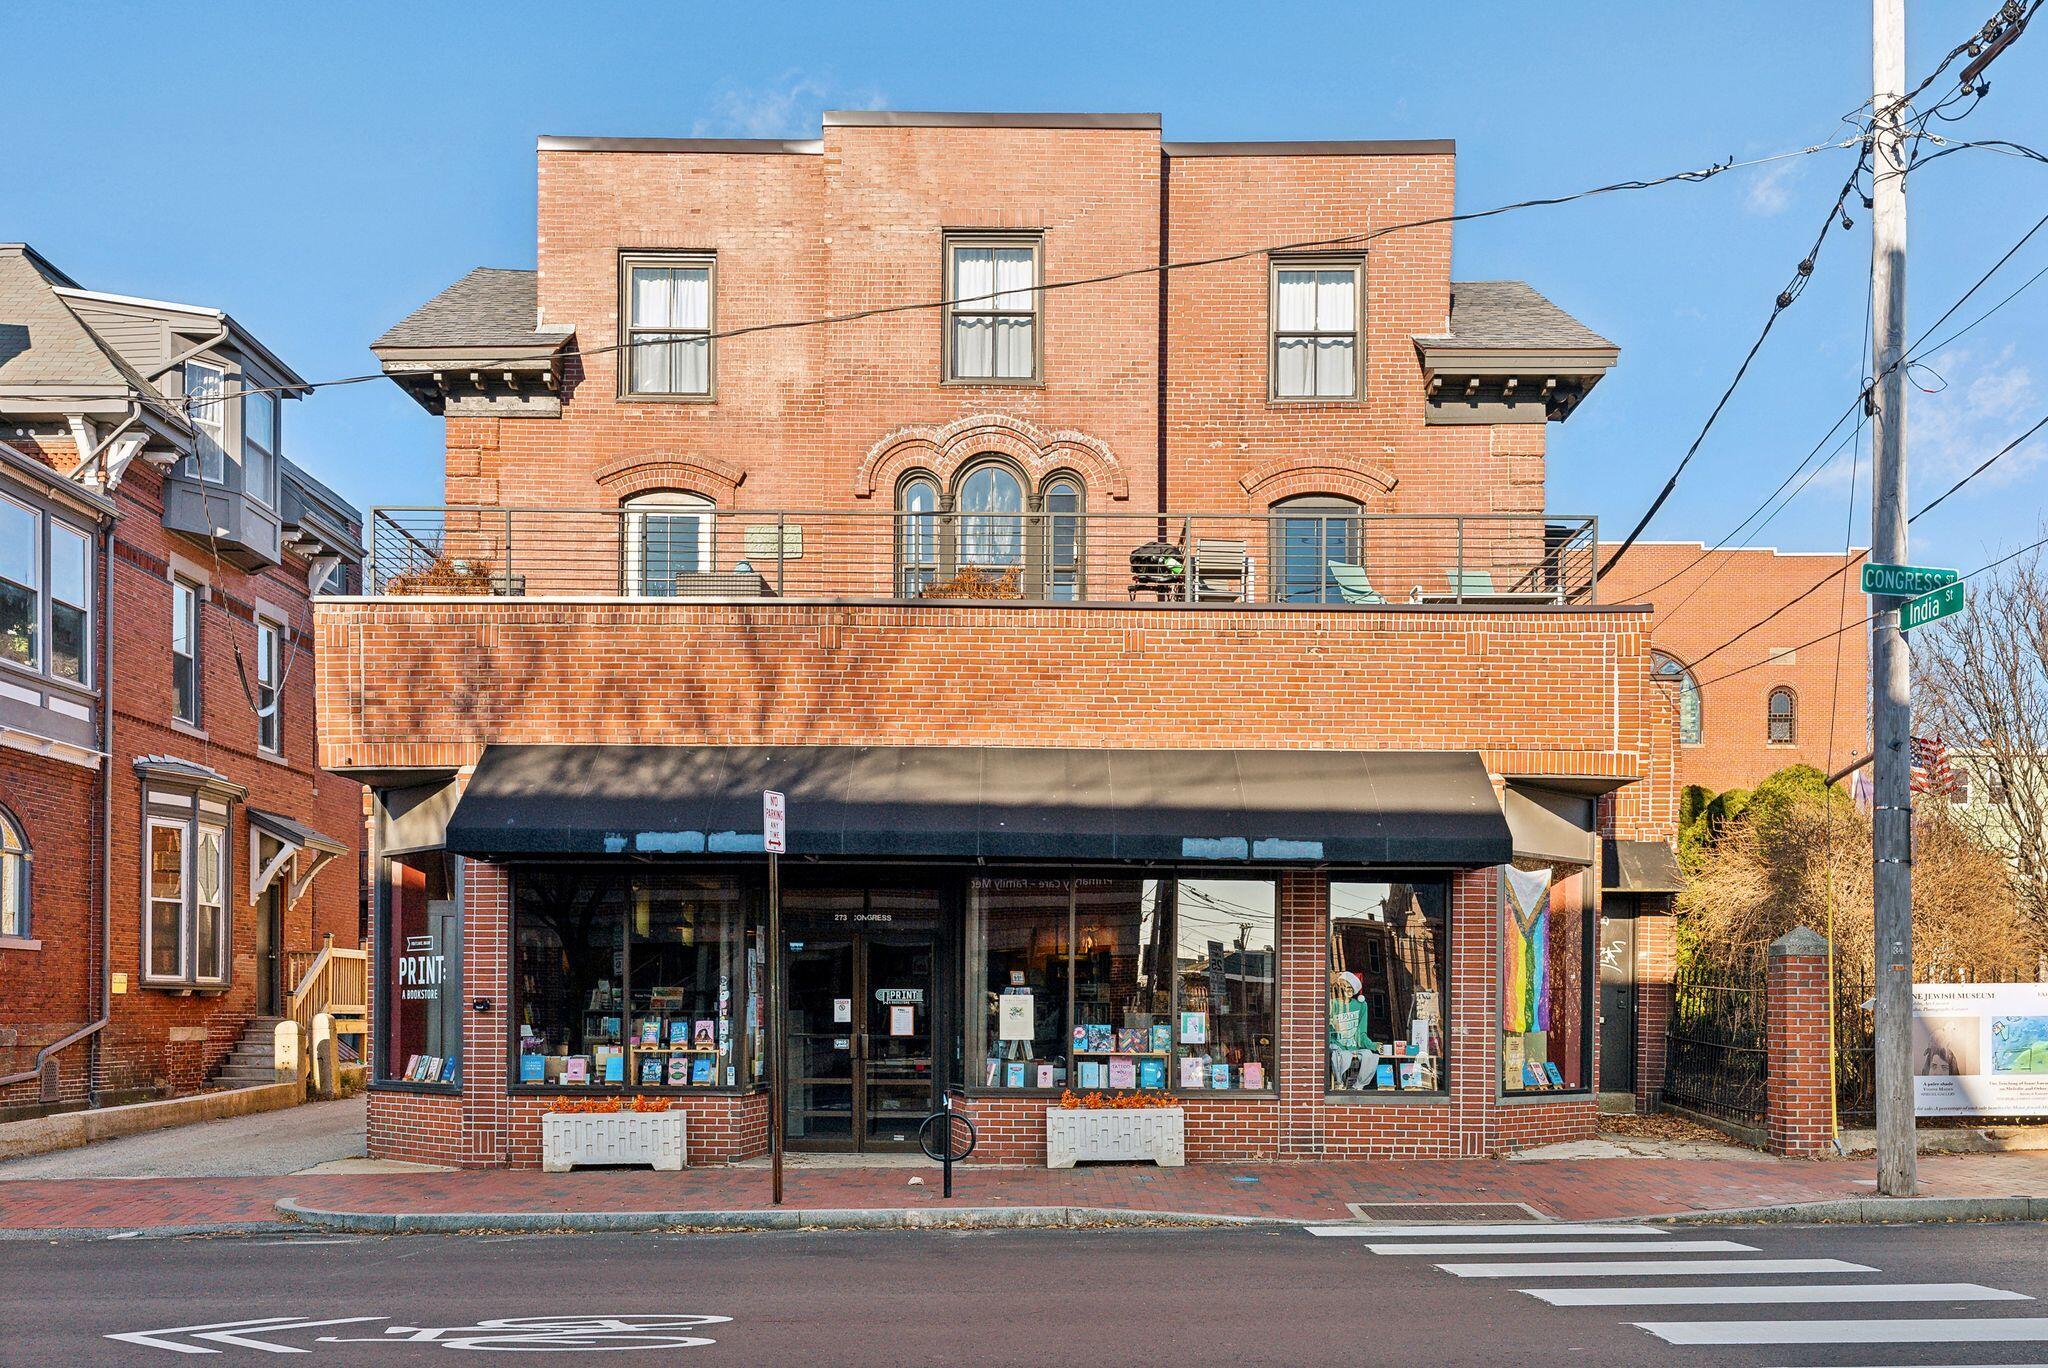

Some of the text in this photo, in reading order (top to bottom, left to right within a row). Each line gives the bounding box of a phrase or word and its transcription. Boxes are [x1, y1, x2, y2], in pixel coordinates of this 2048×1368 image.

[1865, 569, 1954, 591] CONGRESS ST
[1910, 589, 1954, 624] India St
[771, 796, 779, 807] NO
[766, 808, 784, 821] PARKING
[834, 914, 848, 922] 273
[399, 955, 447, 985] PRINT:
[402, 990, 438, 999] A BOOKSTORE
[1924, 992, 1955, 1001] JEWISH
[1955, 992, 1995, 1000] MUSEUM
